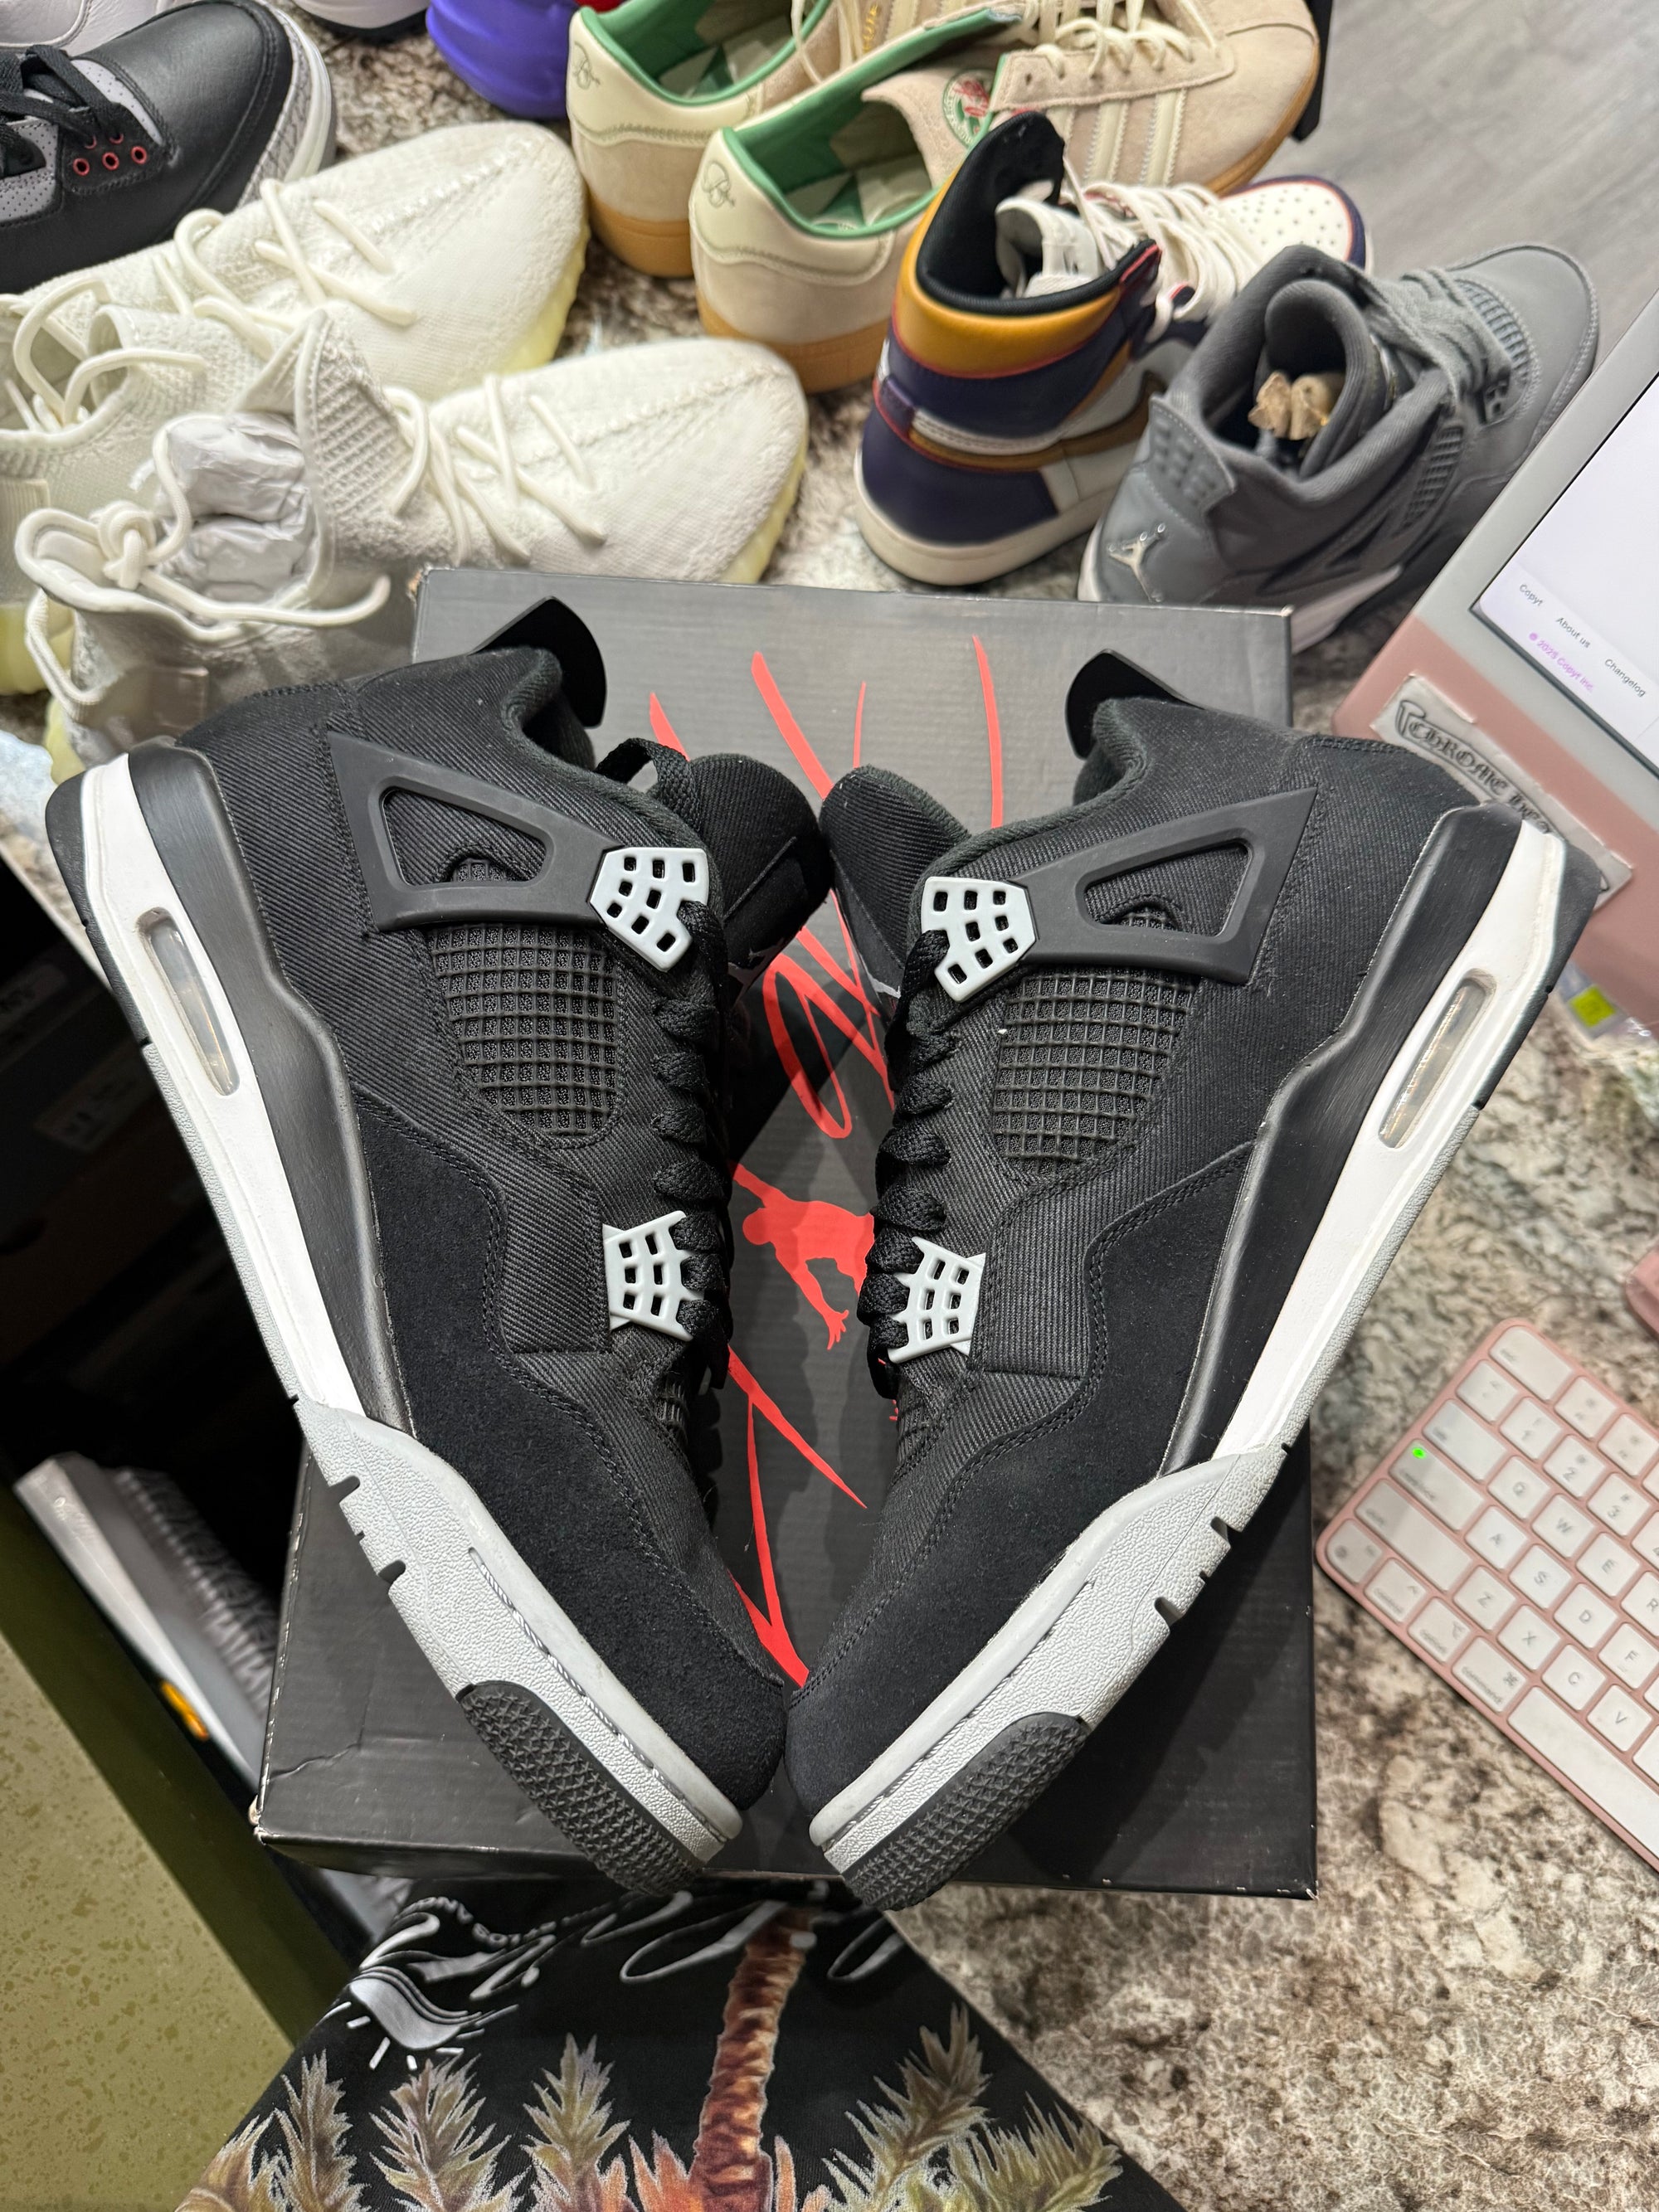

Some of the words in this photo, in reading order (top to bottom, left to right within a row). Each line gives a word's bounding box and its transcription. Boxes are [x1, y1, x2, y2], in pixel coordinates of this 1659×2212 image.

[1555, 617, 1580, 639] About
[1579, 637, 1591, 649] us
[1604, 658, 1647, 698] Changelog
[1563, 1466, 1576, 1482] 2
[1608, 1505, 1621, 1519] 3
[1556, 1517, 1574, 1534] W
[1601, 1558, 1616, 1574] E
[1534, 1571, 1548, 1586] S
[1477, 1592, 1494, 1609] Z
[1579, 1609, 1592, 1624] D
[1521, 1631, 1537, 1647] X
[1624, 1650, 1639, 1662] F
[1568, 1671, 1581, 1685] C
[1615, 1711, 1628, 1725] V
